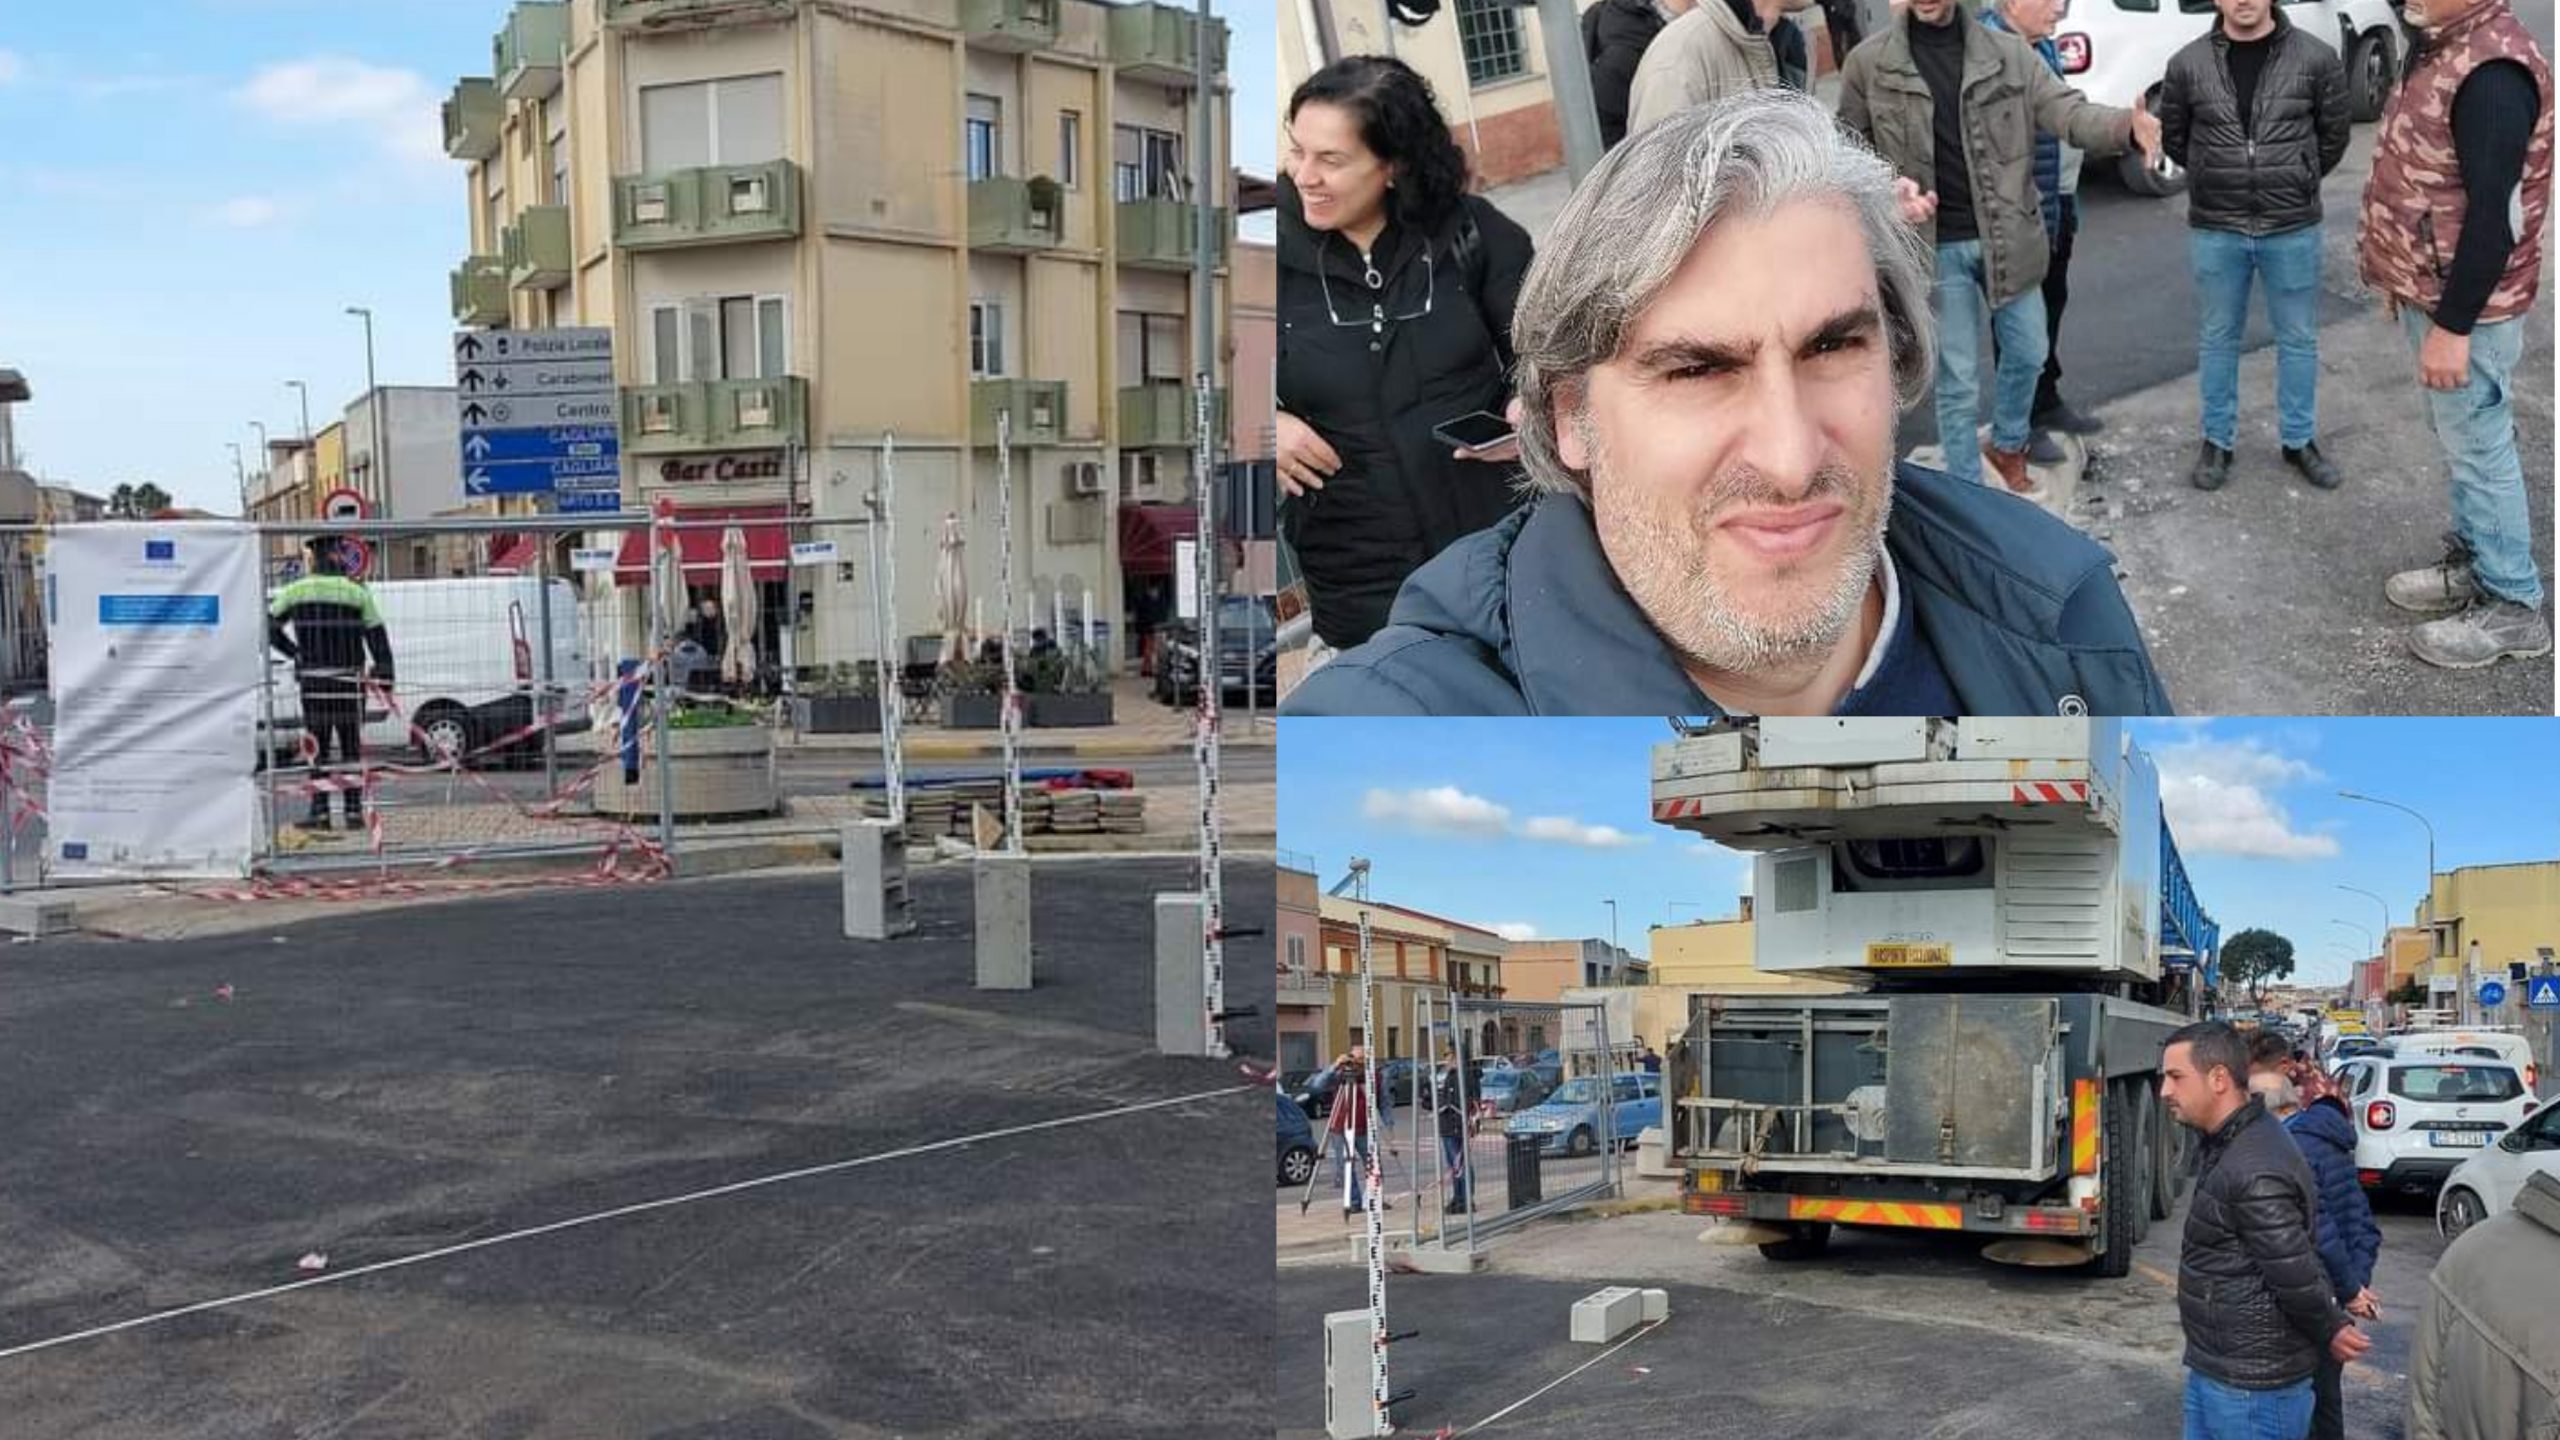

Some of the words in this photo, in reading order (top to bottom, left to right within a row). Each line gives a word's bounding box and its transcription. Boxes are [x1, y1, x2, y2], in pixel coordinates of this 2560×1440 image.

[522, 338, 565, 353] Polizia
[556, 402, 611, 418] Centro
[661, 458, 710, 482] Bar
